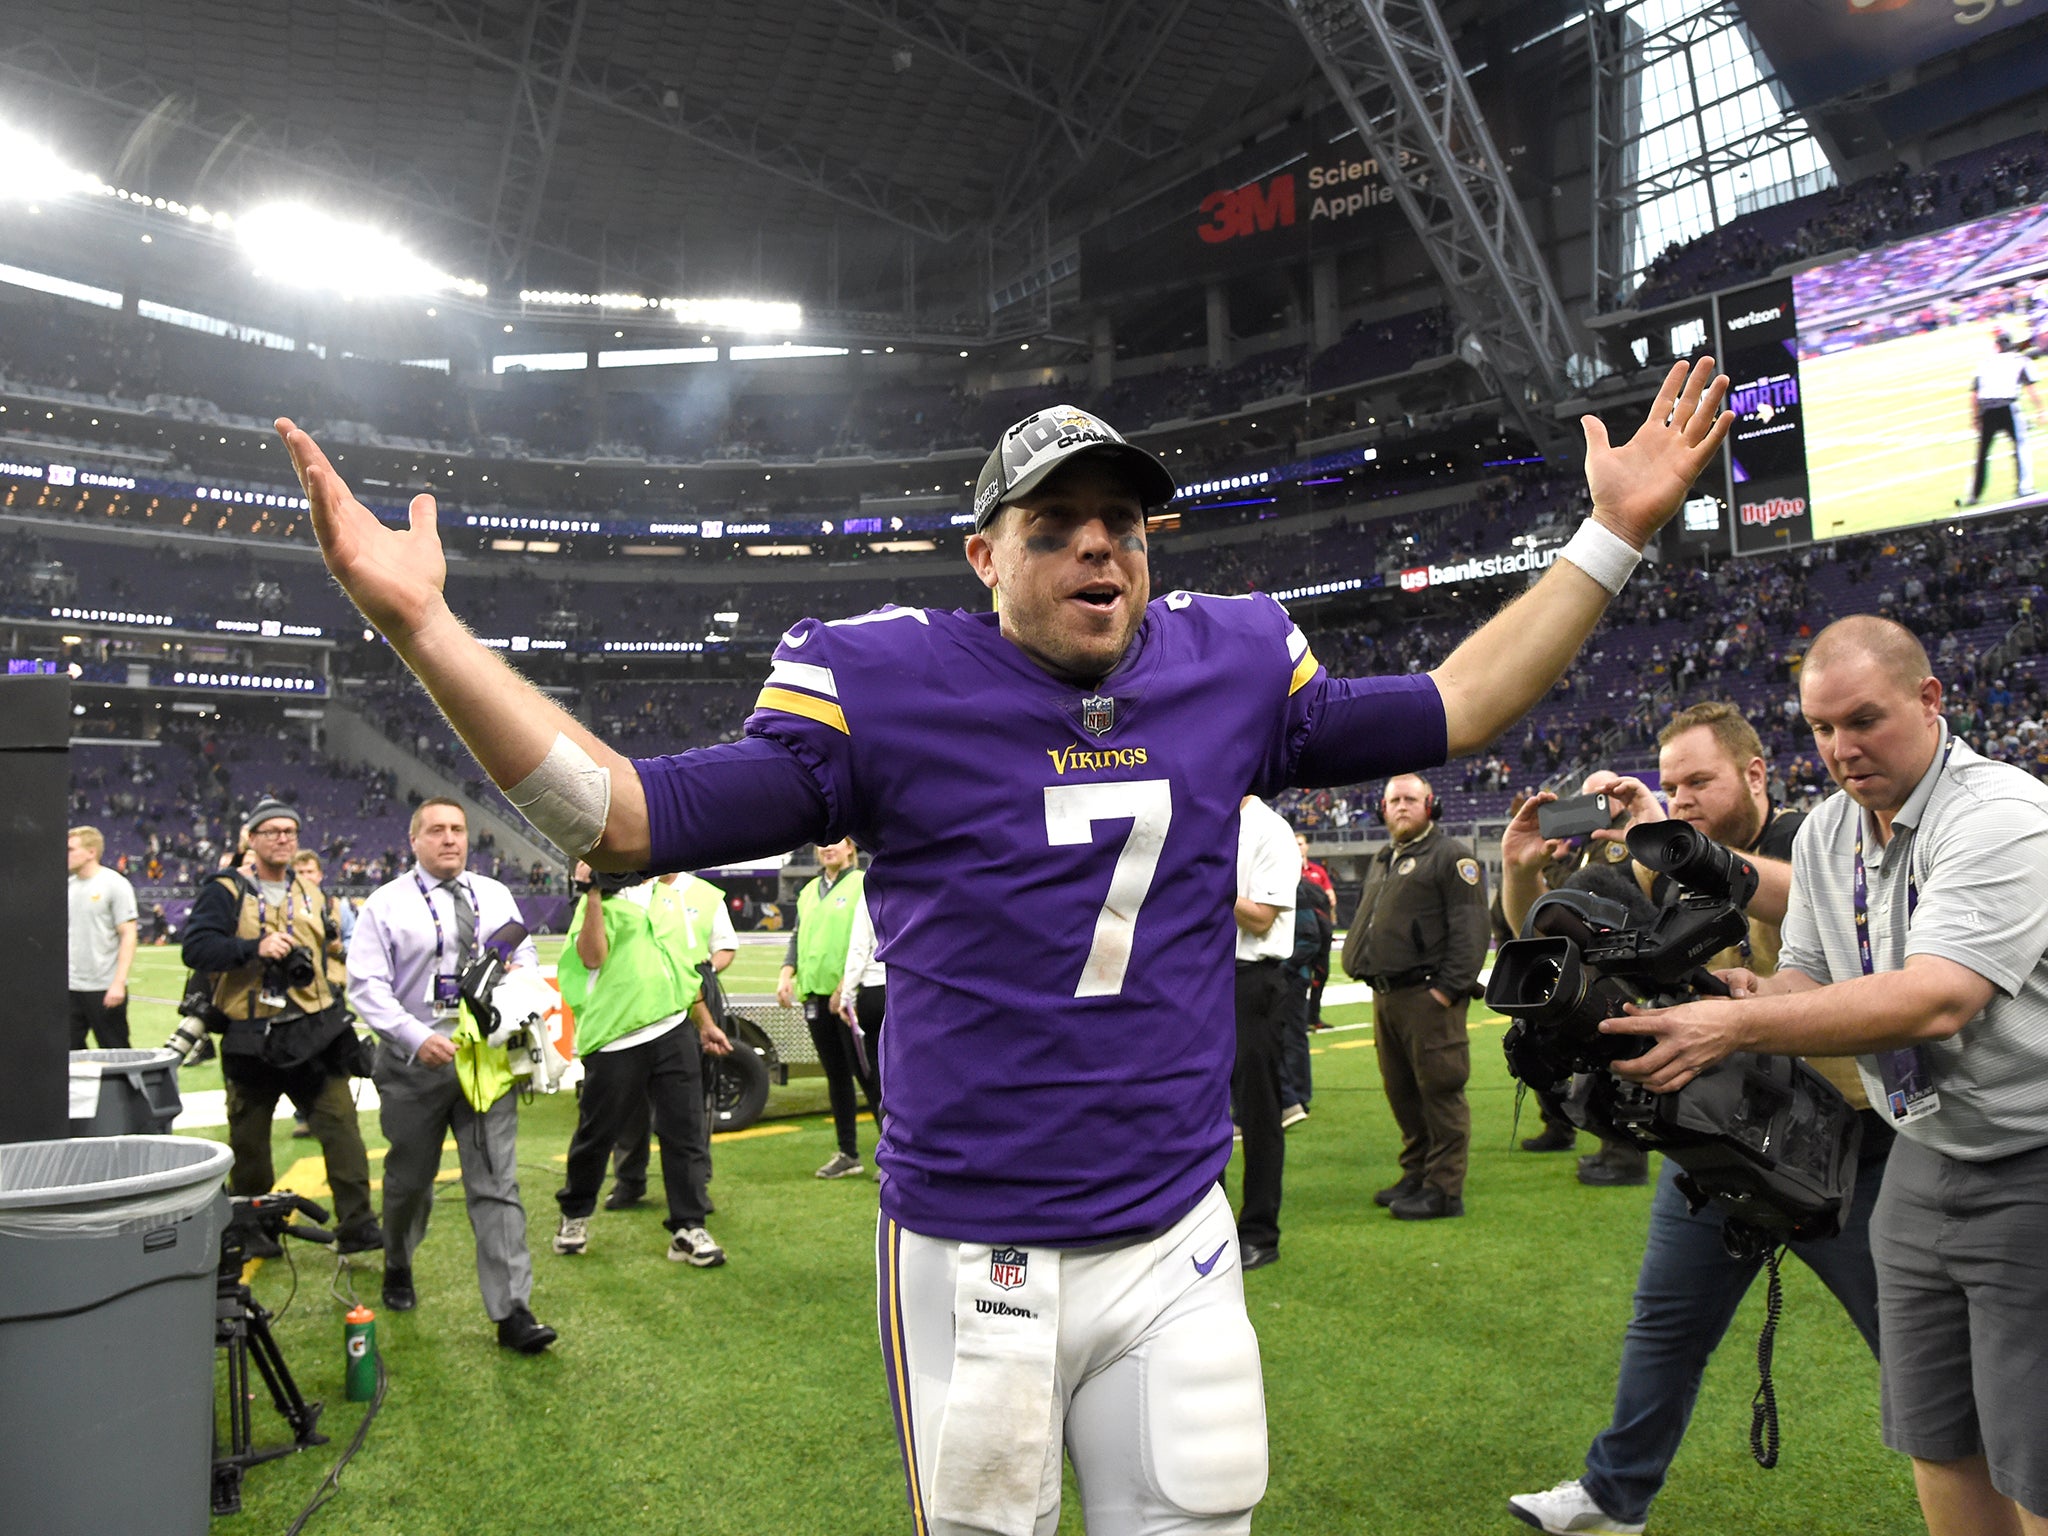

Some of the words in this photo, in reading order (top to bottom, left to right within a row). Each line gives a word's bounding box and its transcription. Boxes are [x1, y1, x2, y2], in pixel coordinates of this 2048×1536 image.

[1308, 150, 1418, 189] Sciene.
[1197, 174, 1296, 243] 3M
[1309, 183, 1395, 220] Applie
[1727, 307, 1781, 330] verizon
[1730, 377, 1798, 416] NORTH
[1088, 712, 1111, 729] NFL
[1043, 778, 1172, 998] 7
[992, 1264, 1024, 1286] NFL
[975, 1298, 1032, 1320] Wilson
[347, 1334, 366, 1358] G
